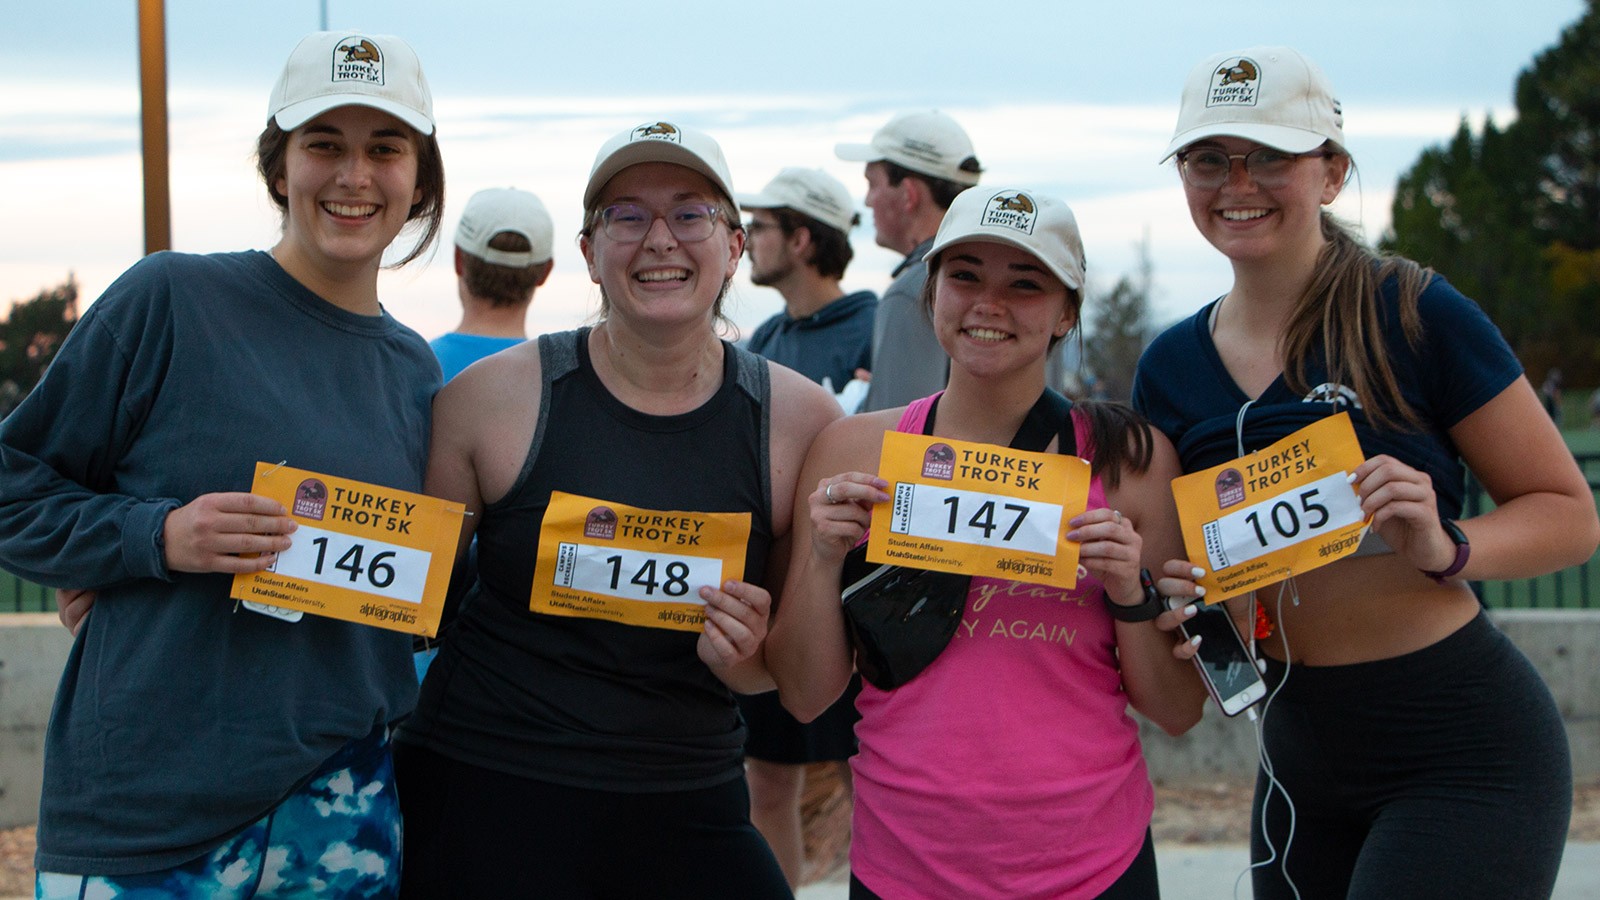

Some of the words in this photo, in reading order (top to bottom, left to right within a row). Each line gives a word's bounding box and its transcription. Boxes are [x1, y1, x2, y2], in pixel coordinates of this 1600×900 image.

[337, 64, 379, 76] TURKEY
[337, 71, 365, 79] TROT
[366, 74, 380, 82] 5K
[1211, 95, 1237, 104] TROT
[1239, 95, 1252, 103] 5K
[1213, 87, 1254, 96] TURKEY
[987, 217, 1013, 225] TROT
[1015, 222, 1028, 230] 5K
[989, 210, 1030, 223] TURKEY
[925, 462, 952, 470] TURKEY
[963, 450, 1043, 474] TURKEY
[1247, 439, 1310, 476] TURKEY
[960, 465, 1011, 484] TROT
[1015, 475, 1040, 491] 5K
[1248, 467, 1291, 492] TROT
[1295, 456, 1318, 475] 5K
[296, 505, 313, 513] TROT
[297, 499, 324, 509] TURKEY
[334, 487, 416, 516] TURKEY
[896, 485, 904, 515] CAMPUS
[901, 486, 911, 531] RECREATION
[331, 505, 381, 527] TROT
[385, 518, 412, 534] 5K
[624, 514, 705, 532] TURKEY
[944, 496, 1030, 542] 147
[1245, 489, 1330, 547] 105
[622, 525, 672, 542] TROT
[676, 534, 701, 545] 5K
[888, 538, 918, 549] Student
[919, 543, 944, 552] Affairs
[1205, 526, 1215, 555] CAMPUS
[1211, 523, 1225, 566] RECREATION
[312, 536, 397, 588] 146
[558, 545, 567, 571] CAMPUS
[564, 546, 574, 585] RECREATION
[996, 558, 1054, 577] alphagraphics
[254, 575, 284, 588] Student
[285, 582, 309, 593] Affairs
[606, 555, 689, 596] 148
[1216, 569, 1244, 584] Student
[550, 590, 581, 601] Student
[359, 603, 417, 625] alphagraphics
[988, 619, 1077, 647] AGAIN
